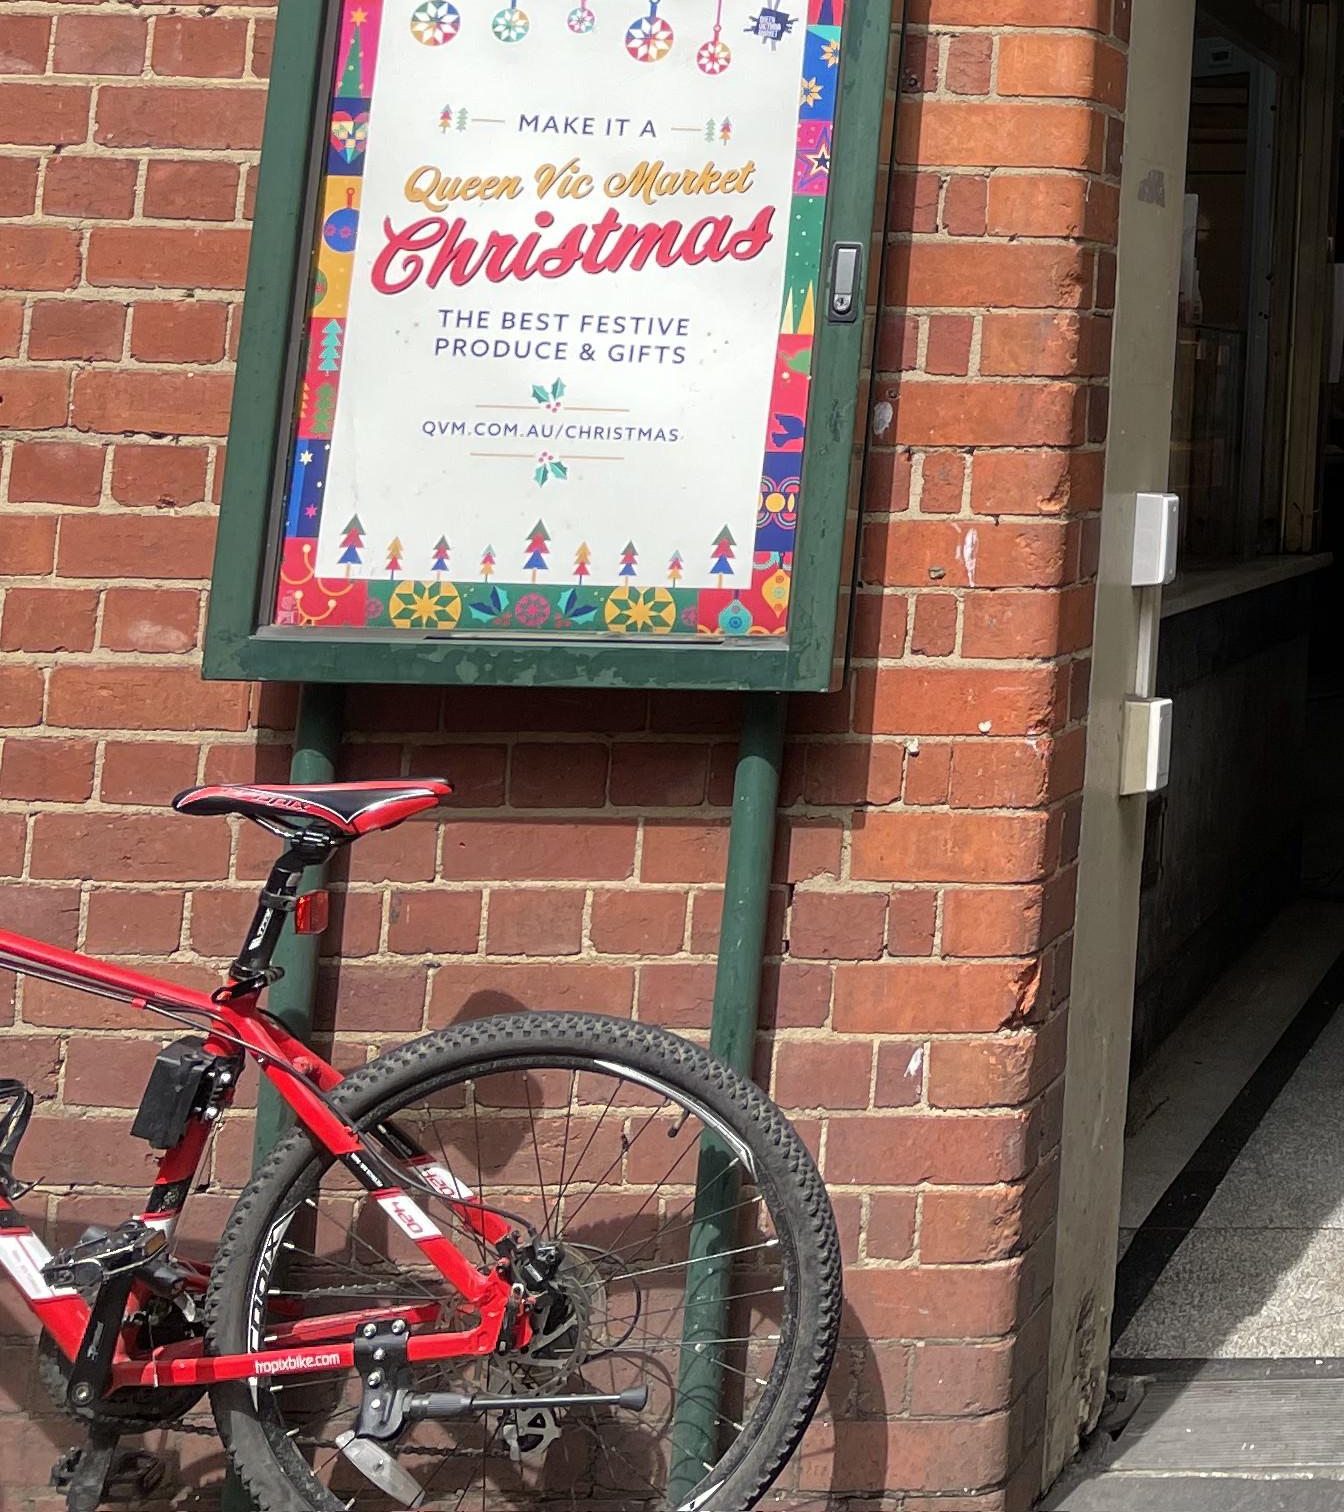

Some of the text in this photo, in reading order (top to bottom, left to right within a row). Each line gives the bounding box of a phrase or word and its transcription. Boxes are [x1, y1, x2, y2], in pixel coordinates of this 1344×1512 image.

[519, 113, 659, 139] MAKE IT A
[403, 156, 755, 212] Queen Vic Market
[370, 204, 777, 296] Christmas
[438, 308, 691, 337] THE BEST FESTIVE
[434, 337, 687, 366] PRODUCE & GIFTS
[422, 419, 681, 444] QVM.COM.AU/CHRISTMAS
